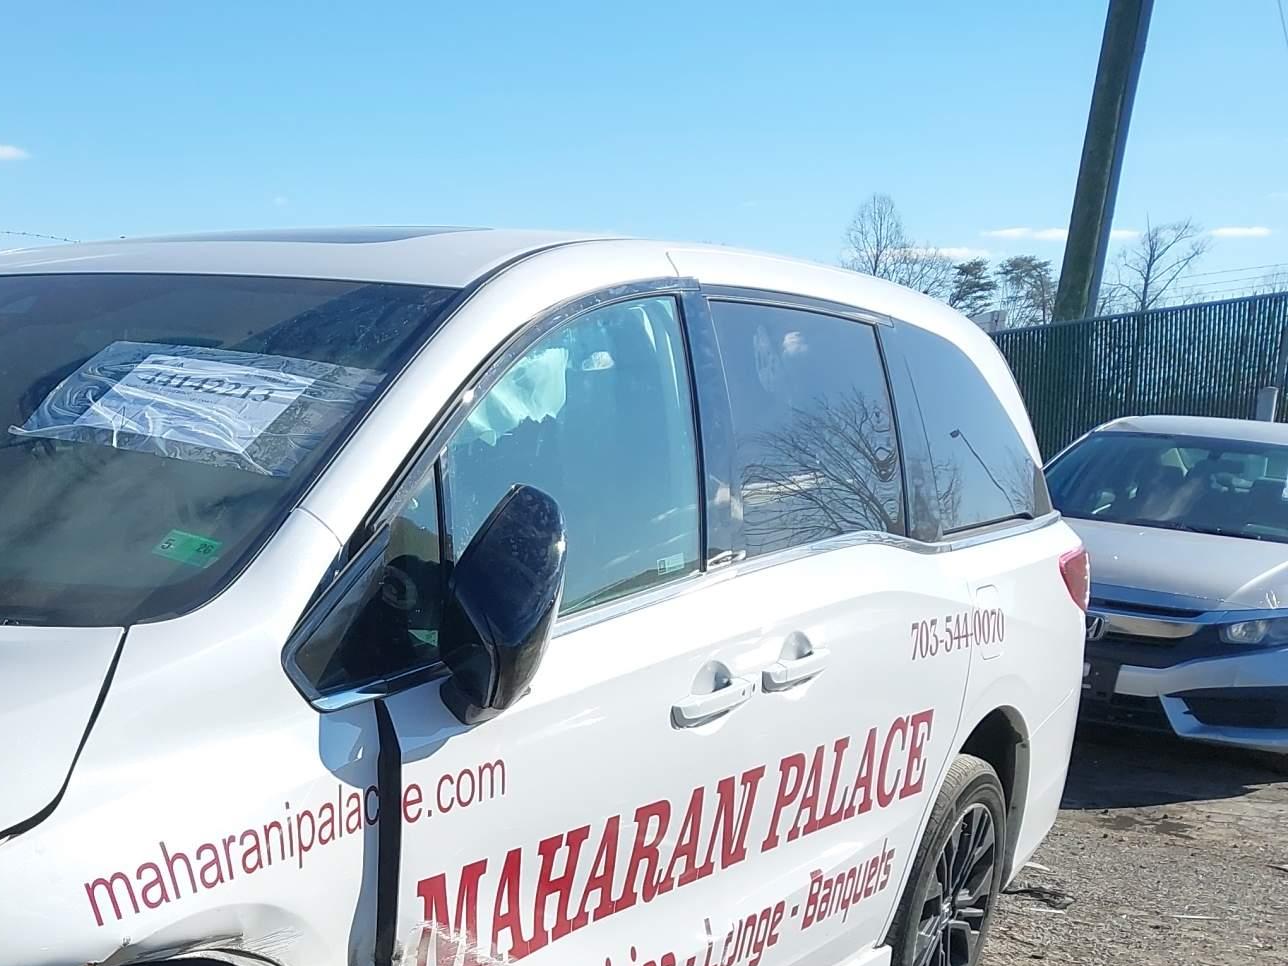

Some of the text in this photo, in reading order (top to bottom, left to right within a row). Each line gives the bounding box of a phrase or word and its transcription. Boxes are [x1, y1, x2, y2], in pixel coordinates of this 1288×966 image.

[911, 608, 1005, 660] 703-544-0070
[760, 709, 935, 853] PALACE
[83, 758, 506, 928] maharanipalace.com
[801, 838, 895, 930] Banquets
